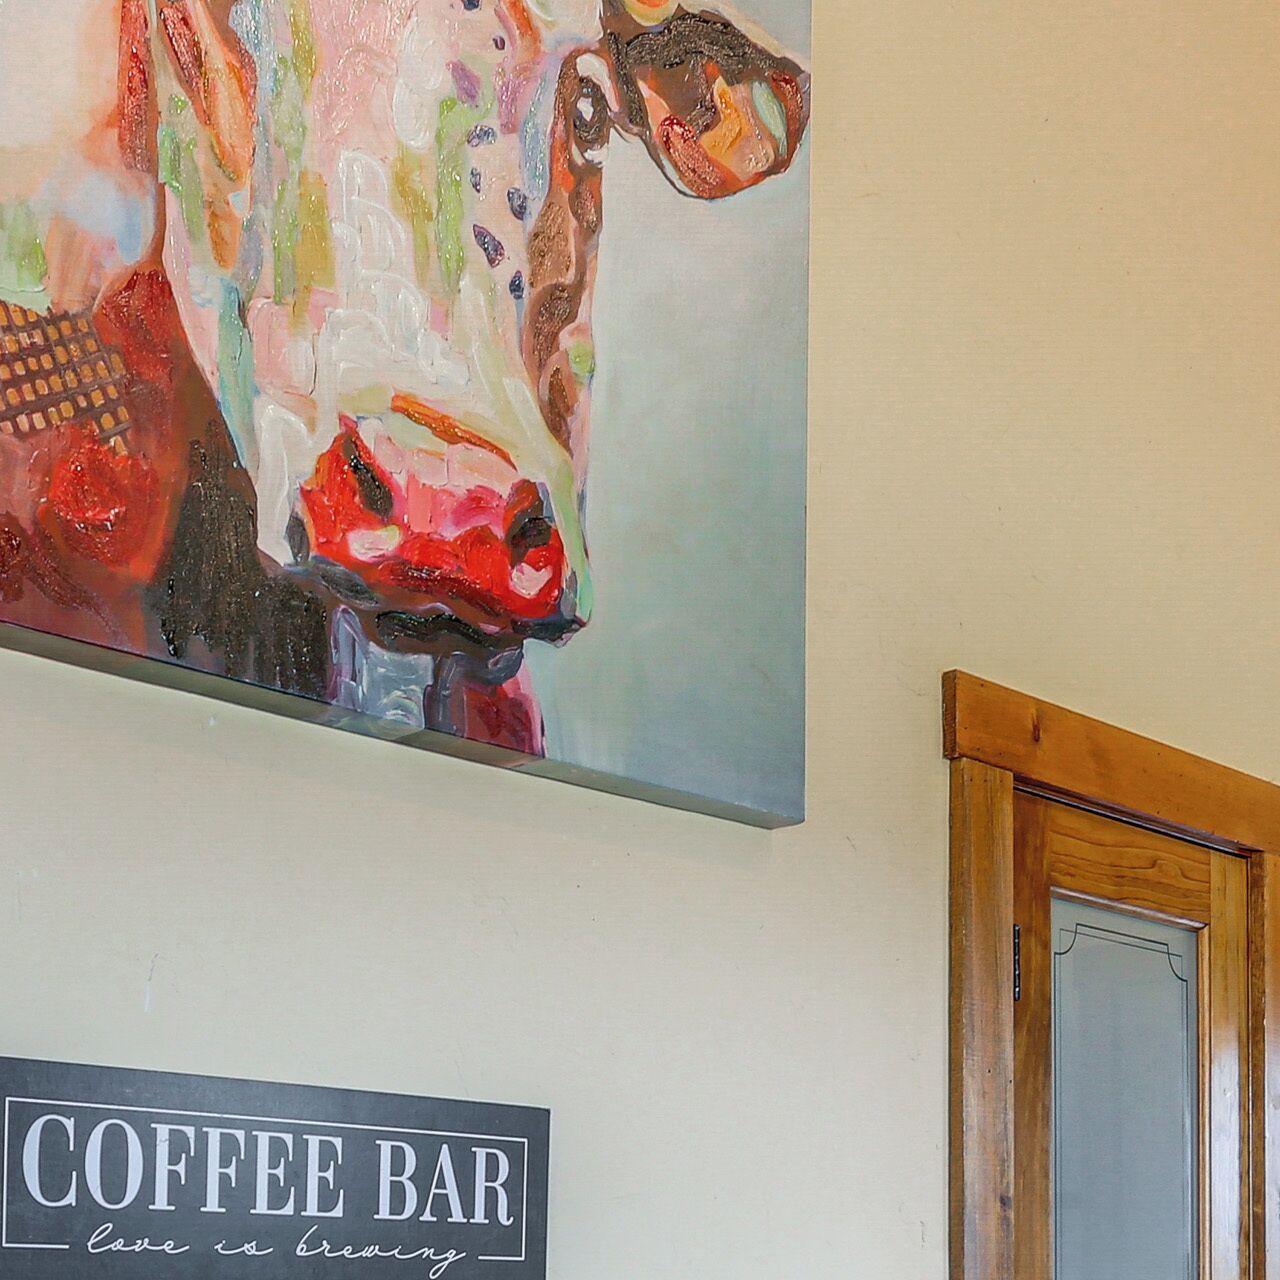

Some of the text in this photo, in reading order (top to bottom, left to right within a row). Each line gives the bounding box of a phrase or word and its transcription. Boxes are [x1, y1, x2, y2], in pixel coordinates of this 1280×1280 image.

[22, 1114, 514, 1226] COFFEE BAR
[87, 1222, 467, 1280] love is brewing
